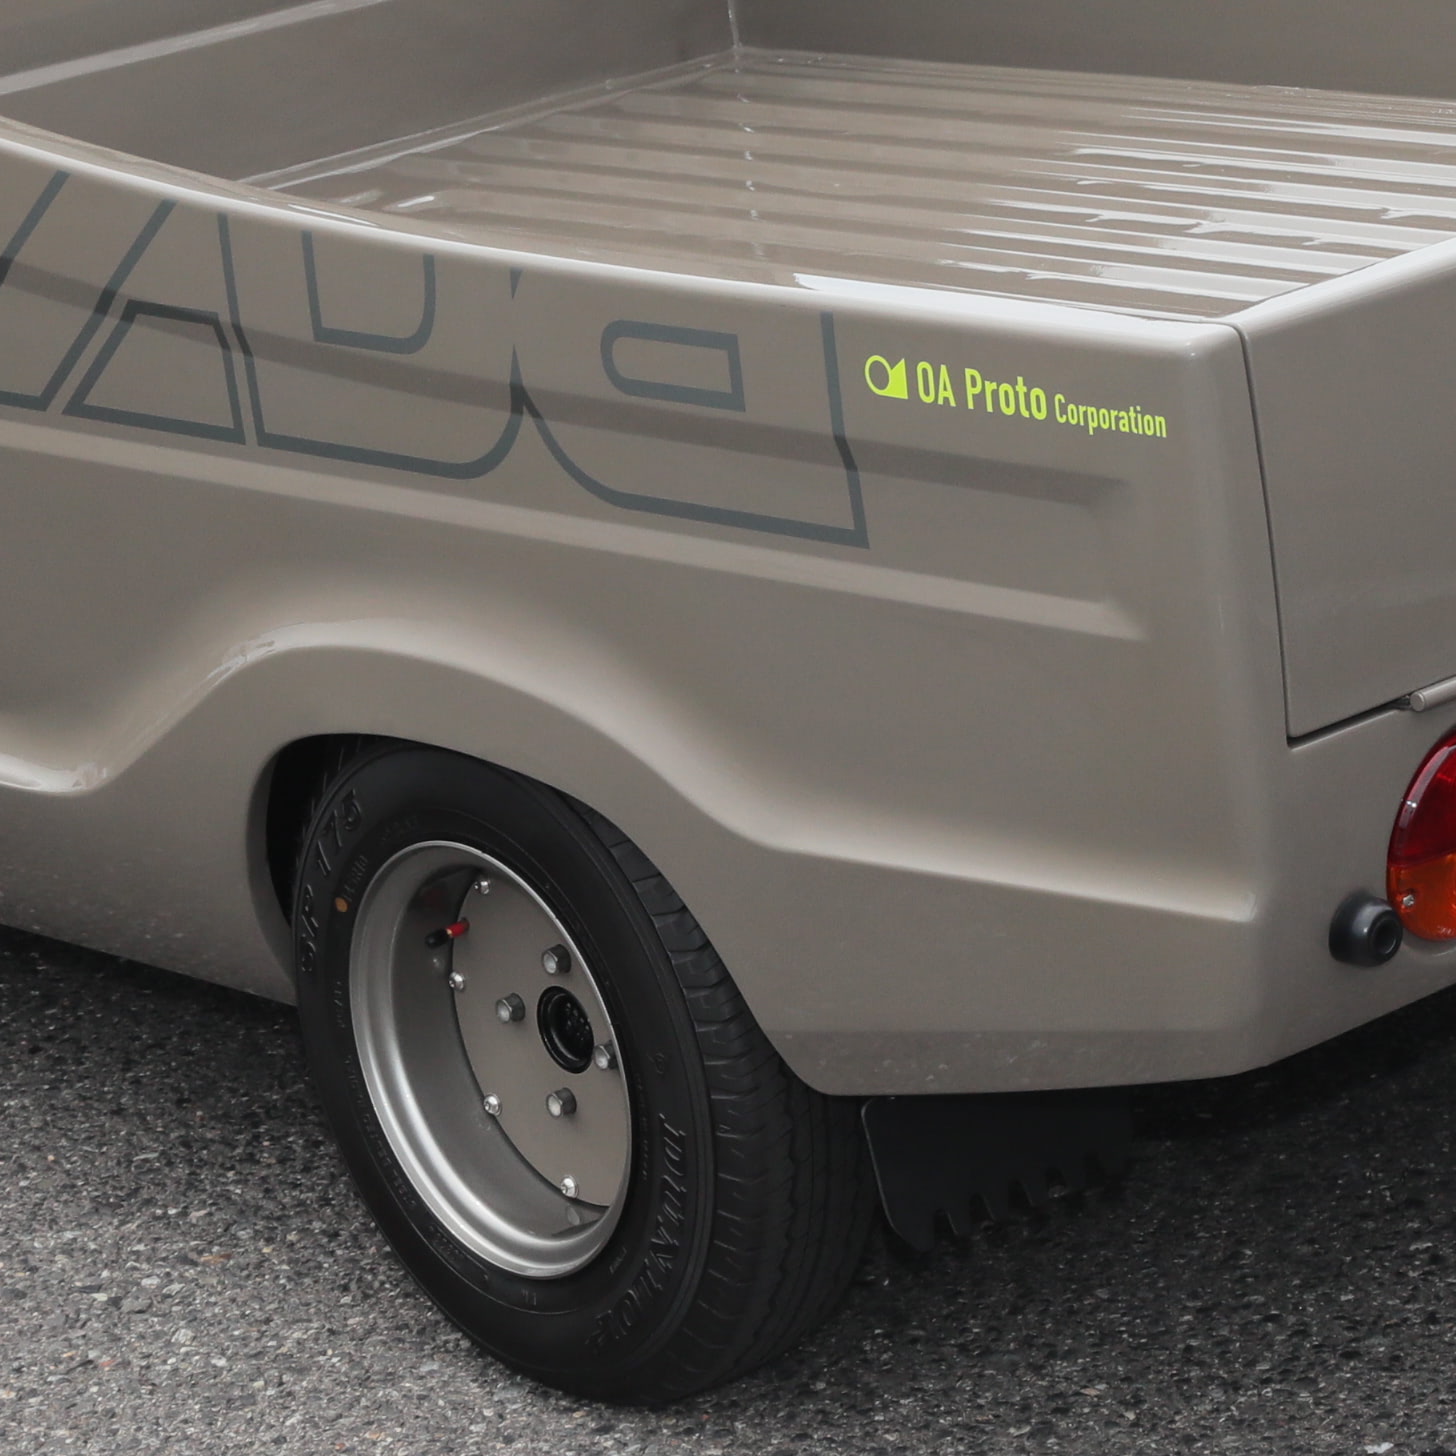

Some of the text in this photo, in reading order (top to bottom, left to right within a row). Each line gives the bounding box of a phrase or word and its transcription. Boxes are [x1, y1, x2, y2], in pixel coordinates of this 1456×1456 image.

[917, 360, 1167, 438] OA Proto Corporation
